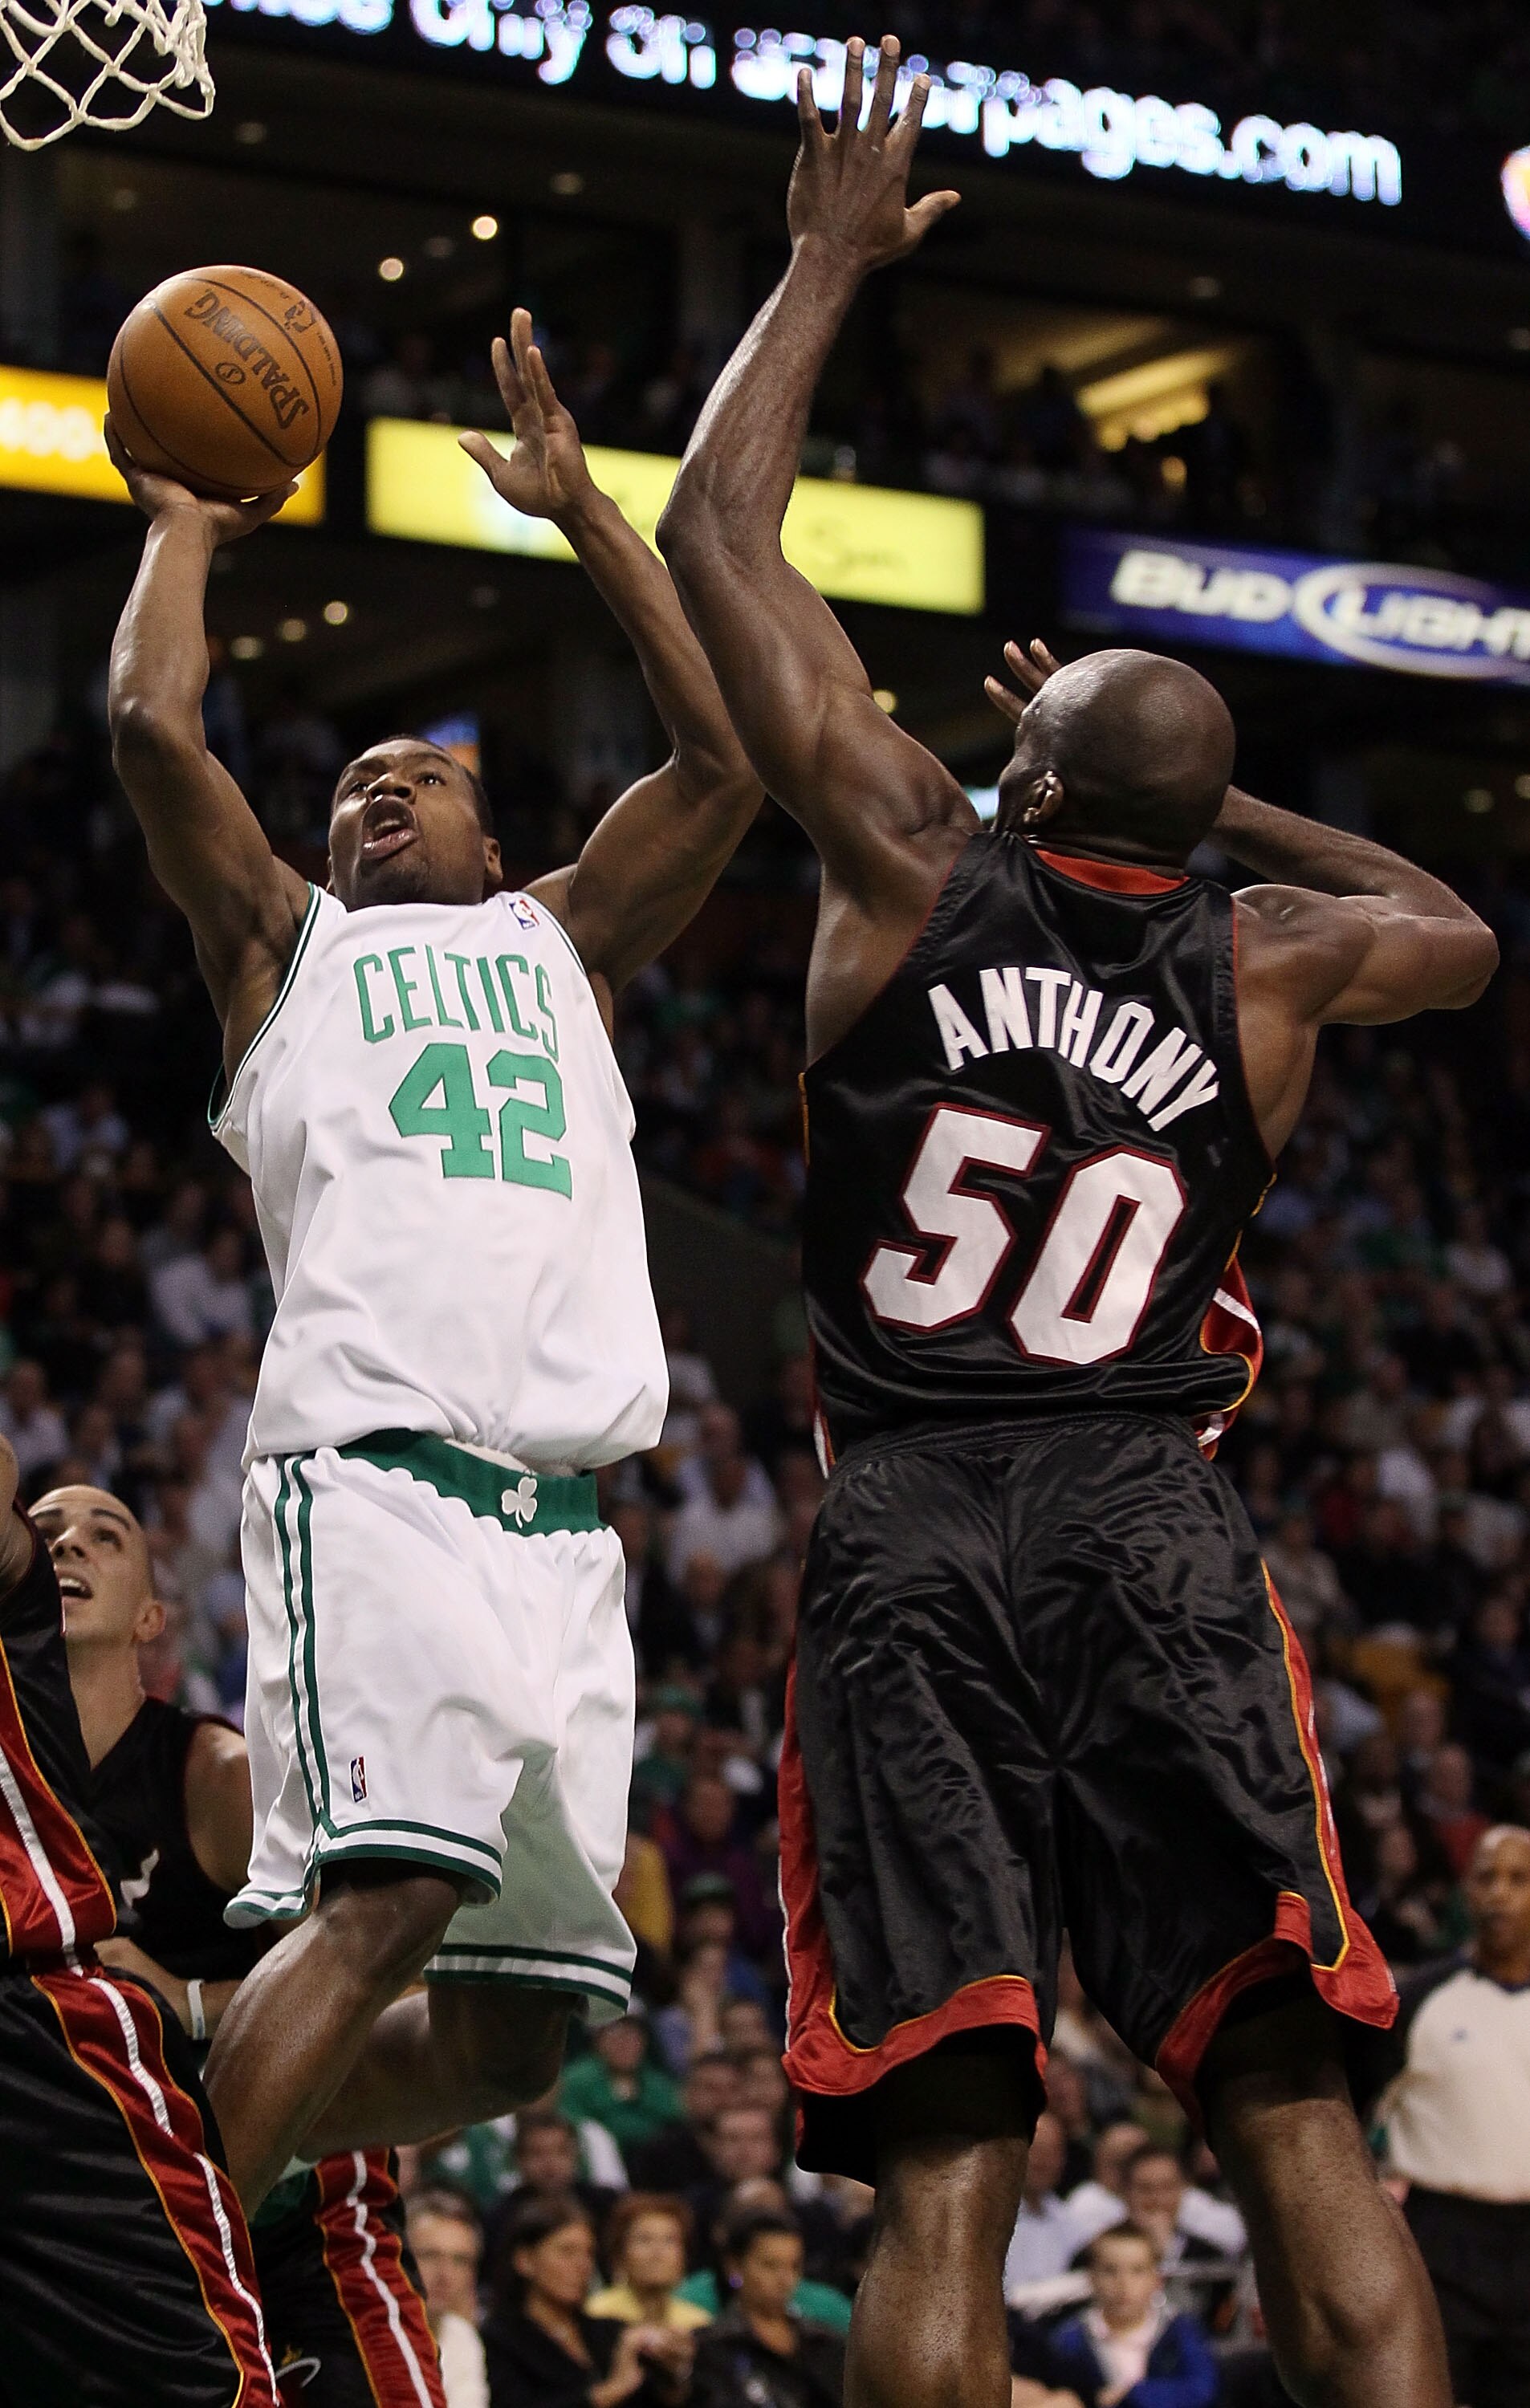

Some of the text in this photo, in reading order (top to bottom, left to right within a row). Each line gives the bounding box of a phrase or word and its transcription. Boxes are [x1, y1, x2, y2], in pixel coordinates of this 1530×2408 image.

[183, 288, 310, 430] SPALDING
[352, 943, 560, 1063] CELTICS
[927, 966, 1220, 1133] ANTHONY
[388, 1043, 572, 1202] 42
[860, 1102, 1189, 1367] 50
